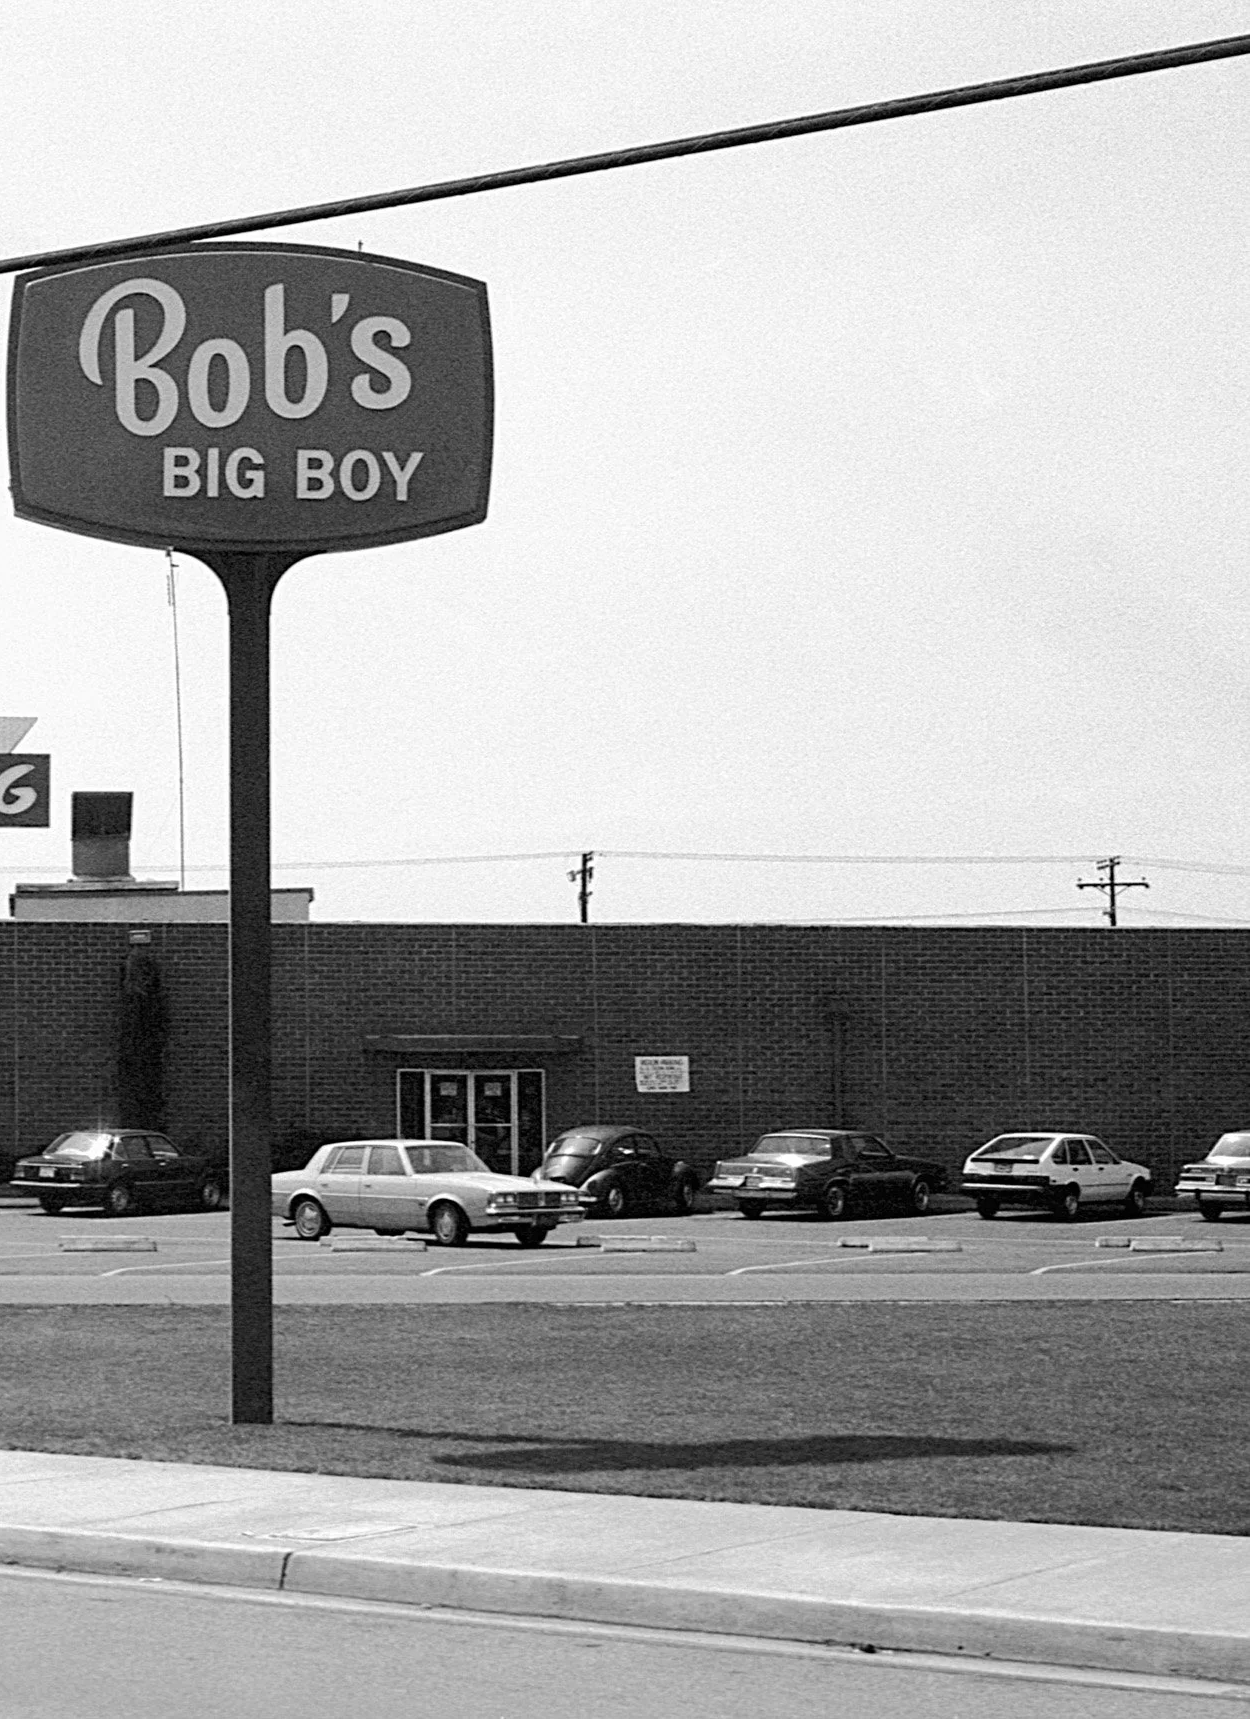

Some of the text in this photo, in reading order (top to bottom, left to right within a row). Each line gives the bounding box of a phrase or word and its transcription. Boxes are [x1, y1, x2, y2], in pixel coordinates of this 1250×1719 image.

[78, 278, 412, 436] Bob's
[163, 447, 424, 502] BIG BOY
